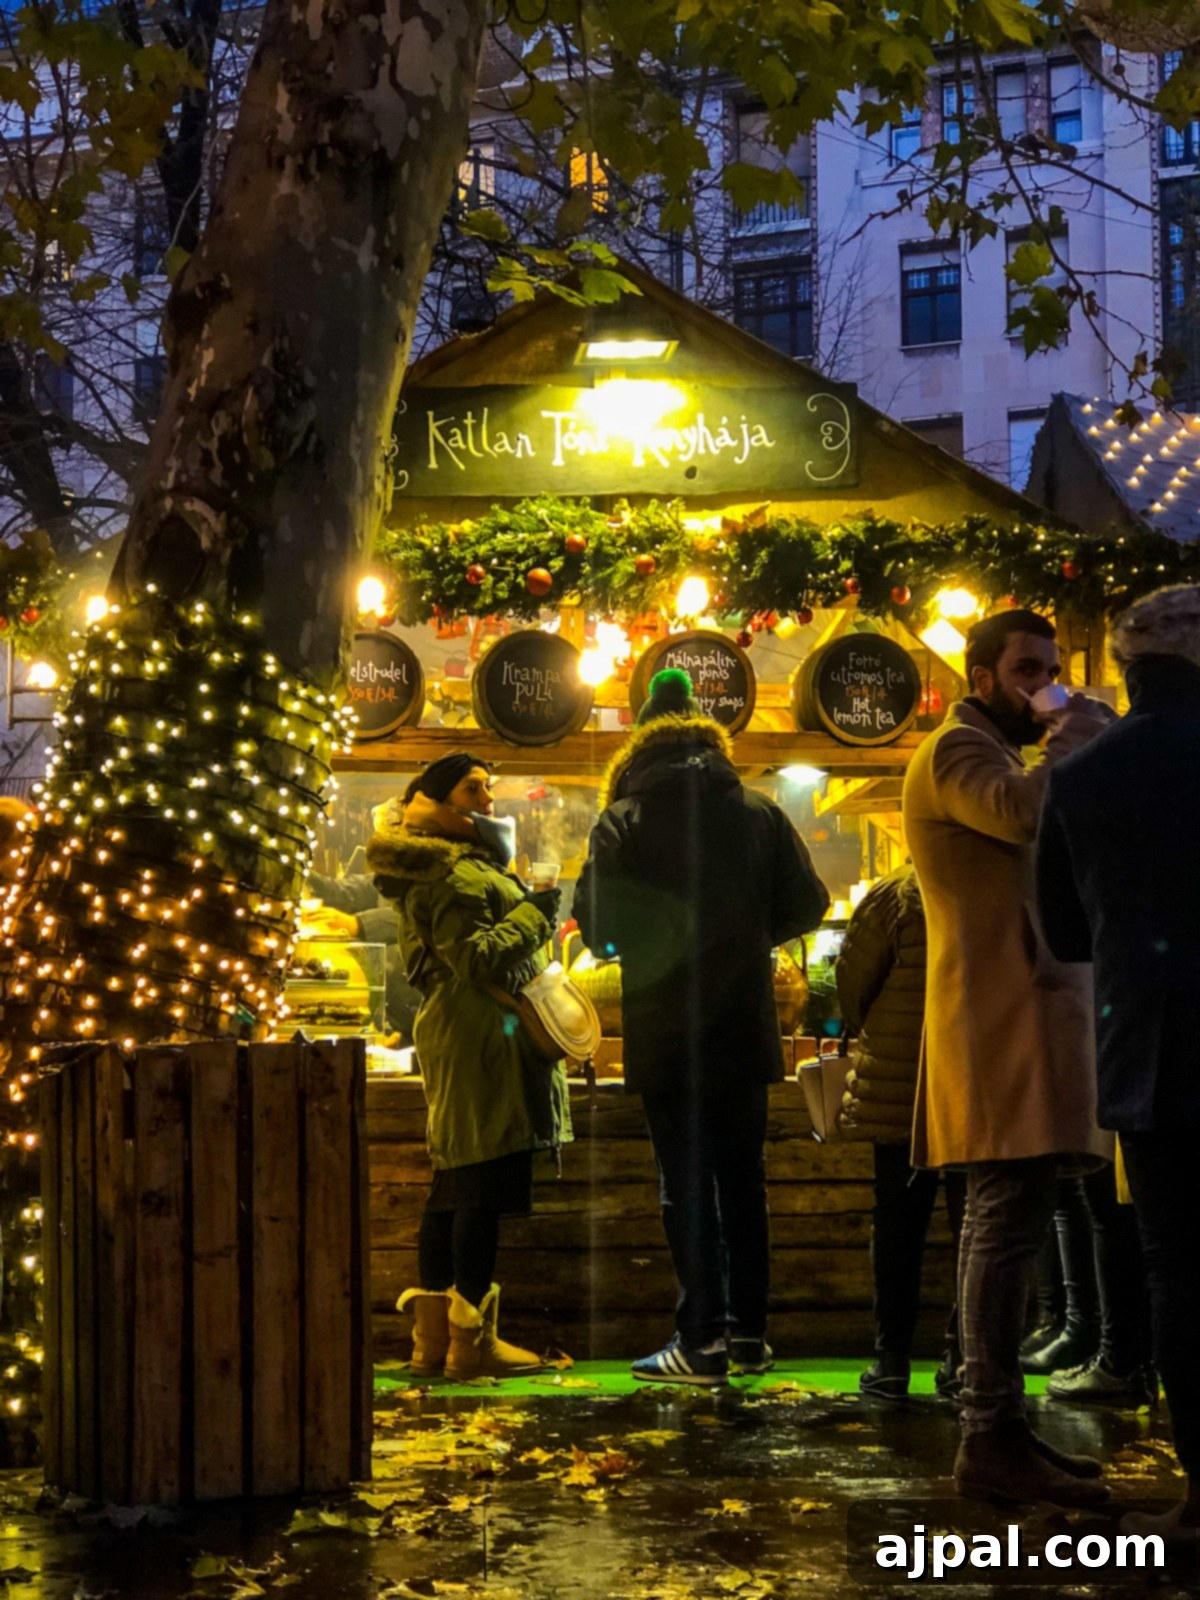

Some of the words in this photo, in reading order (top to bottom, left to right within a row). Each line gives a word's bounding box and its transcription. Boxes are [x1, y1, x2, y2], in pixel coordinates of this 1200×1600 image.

[427, 407, 536, 470] Katlan
[852, 697, 872, 714] Hot
[833, 707, 872, 727] lemon
[874, 707, 897, 730] tea
